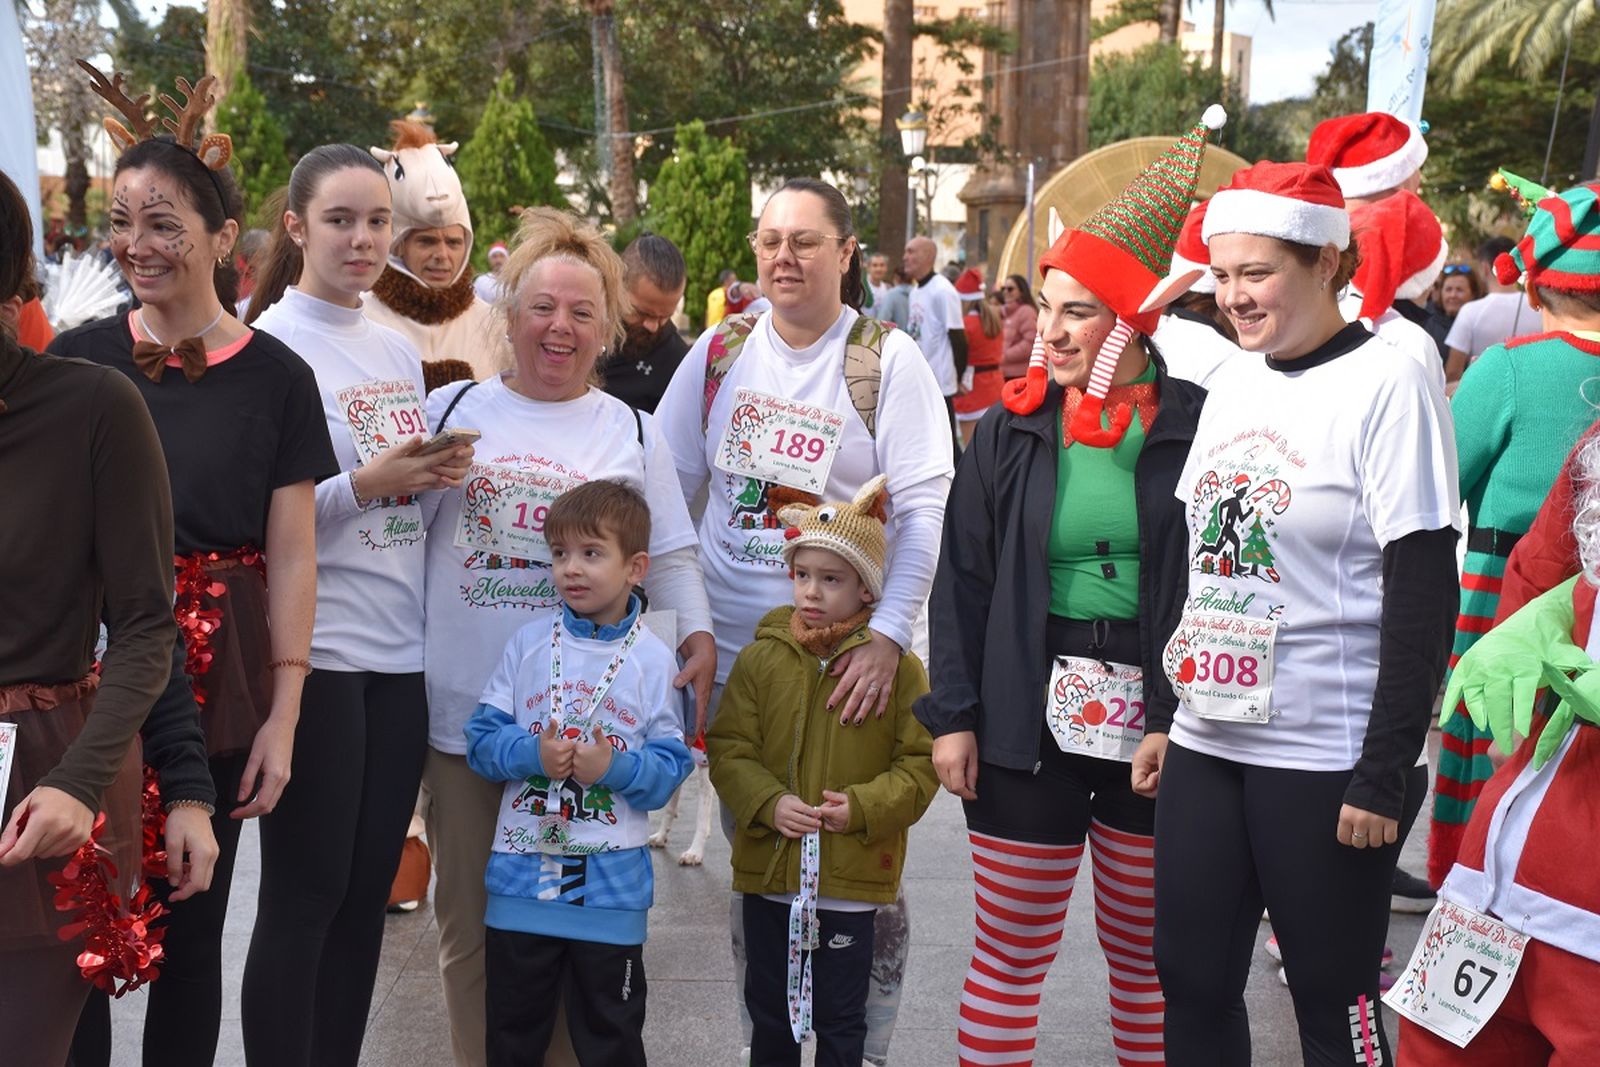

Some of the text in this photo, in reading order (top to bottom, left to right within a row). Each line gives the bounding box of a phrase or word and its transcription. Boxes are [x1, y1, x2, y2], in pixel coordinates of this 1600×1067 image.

[390, 408, 426, 435] 191
[770, 429, 825, 463] 189
[512, 502, 549, 532] 19
[472, 576, 557, 600] Mercedes
[1194, 586, 1255, 614] Anabel
[1197, 650, 1258, 687] 308
[833, 933, 854, 944] NIKE
[1491, 927, 1507, 943] De
[1454, 959, 1498, 1004] 67
